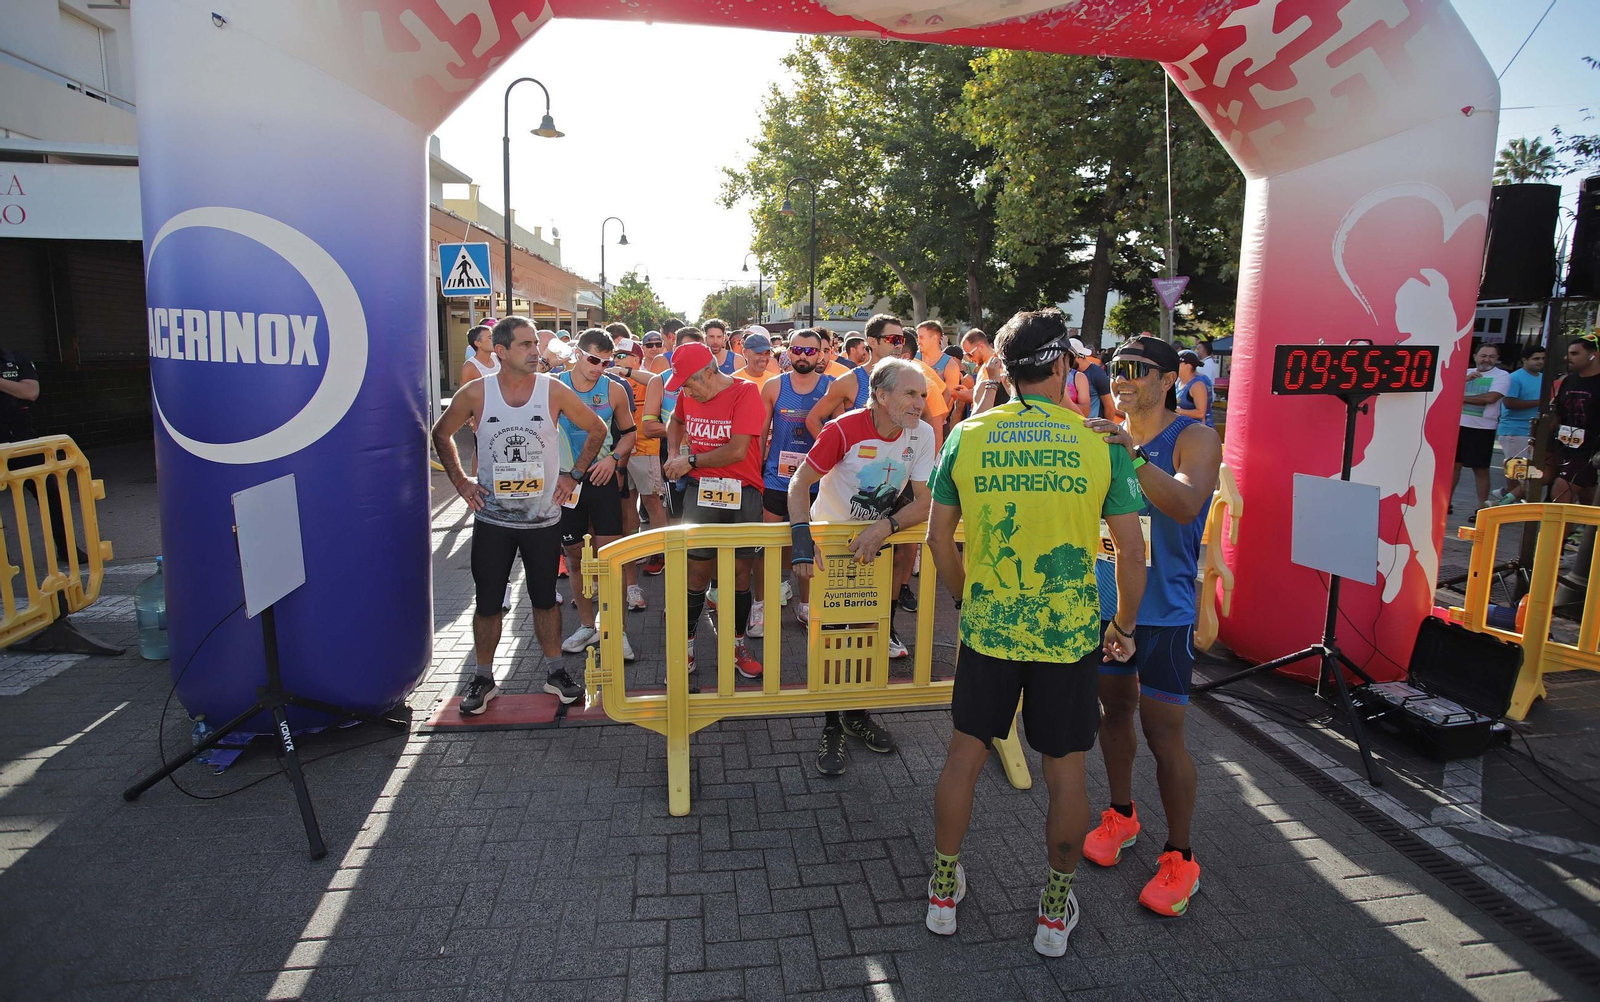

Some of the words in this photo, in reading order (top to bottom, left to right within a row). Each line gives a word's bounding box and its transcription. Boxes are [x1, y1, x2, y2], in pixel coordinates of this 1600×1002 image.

[0, 174, 26, 196] A
[0, 204, 26, 225] O
[148, 307, 319, 366] ACERINOX
[1284, 350, 1432, 390] 09:55:30
[997, 420, 1071, 430] Construcciones
[493, 426, 524, 439] CARRERA
[524, 427, 546, 449] POPULAR
[986, 430, 1054, 444] JUCANSUR,
[1055, 433, 1079, 444] S.L.U.
[981, 449, 1081, 468] RUNNERS
[499, 479, 539, 491] 274
[974, 471, 1088, 495] BARREÑOS
[703, 490, 735, 502] 311
[823, 600, 841, 608] Los
[844, 599, 878, 607] Barrios
[824, 591, 878, 600] Ayuntamiento
[280, 720, 295, 752] VONYX
